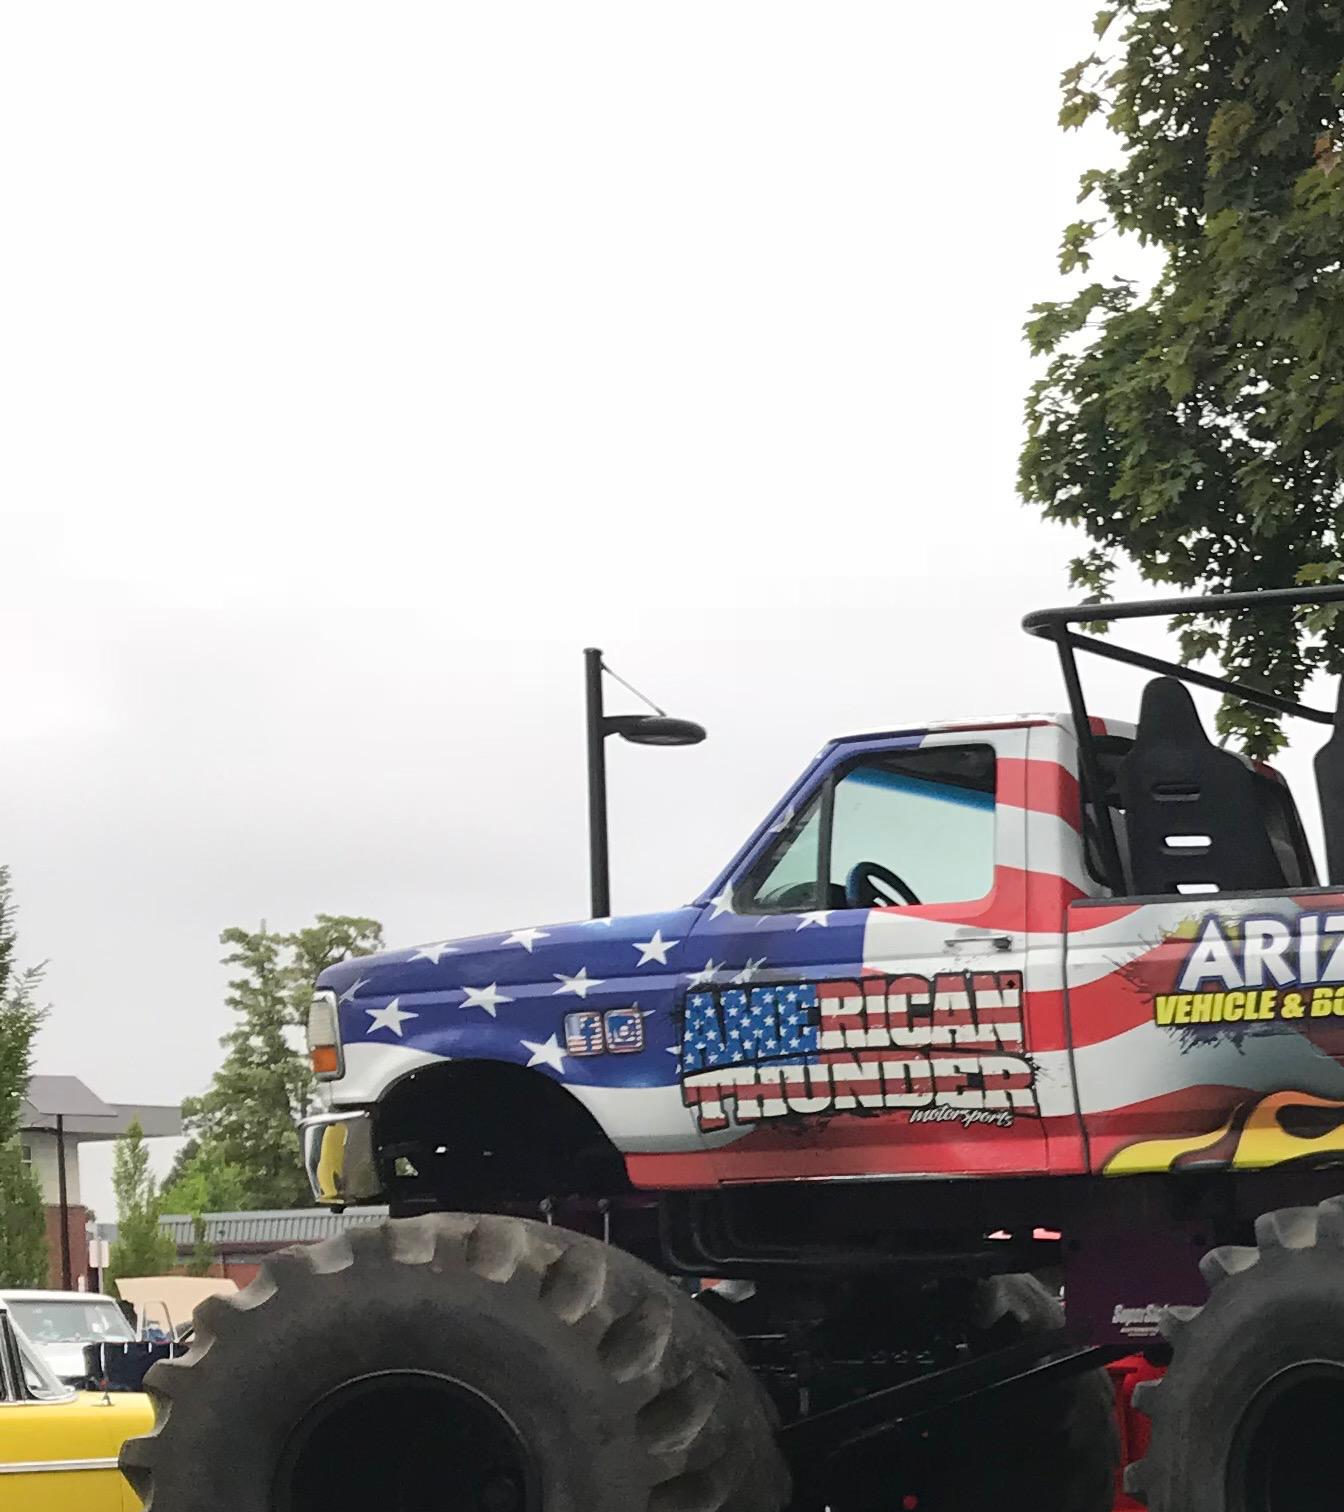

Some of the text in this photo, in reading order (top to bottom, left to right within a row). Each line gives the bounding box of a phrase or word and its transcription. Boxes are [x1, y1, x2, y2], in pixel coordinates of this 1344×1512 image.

[683, 971, 1024, 1073] AMERICAN
[1156, 990, 1277, 1025] VEHICLE
[1281, 993, 1304, 1018] &
[683, 1051, 1041, 1132] THUNDER
[908, 1104, 1014, 1128] motorsports
